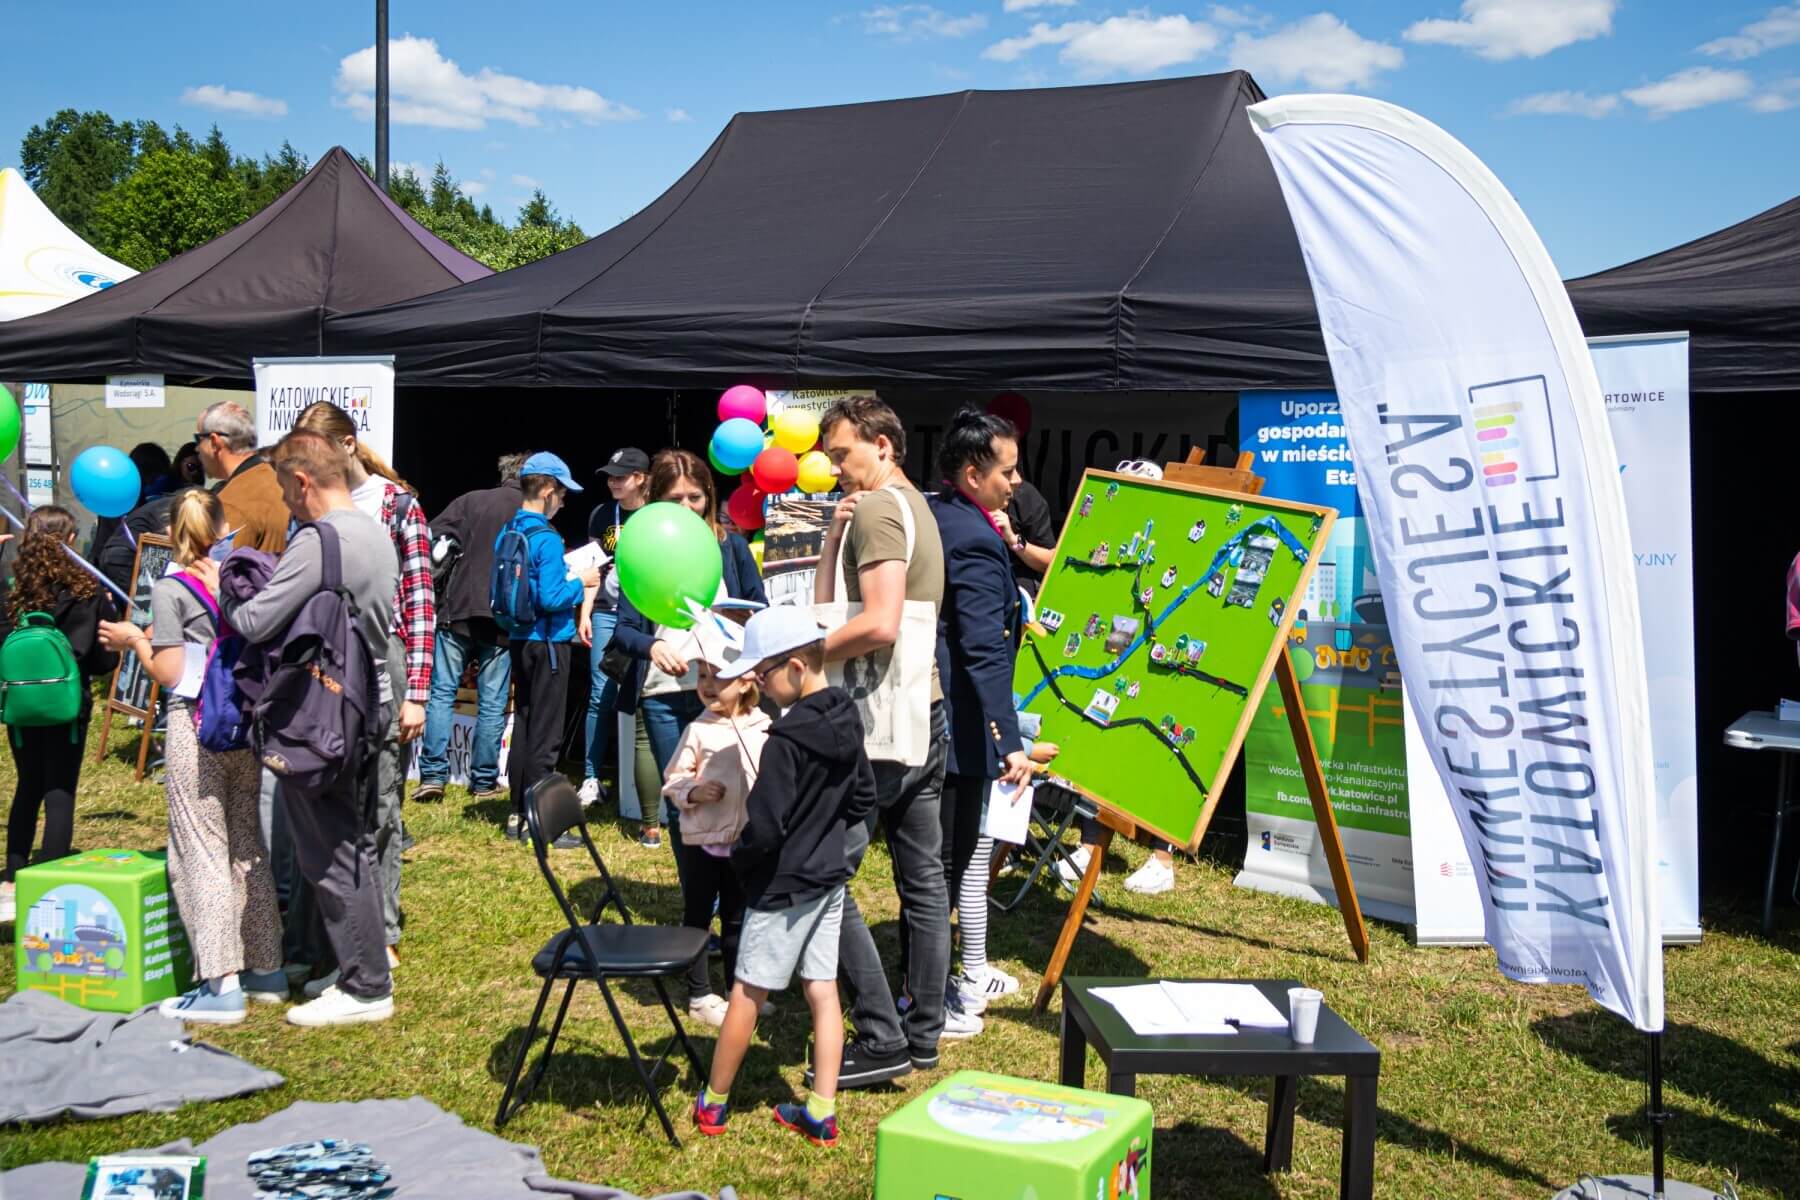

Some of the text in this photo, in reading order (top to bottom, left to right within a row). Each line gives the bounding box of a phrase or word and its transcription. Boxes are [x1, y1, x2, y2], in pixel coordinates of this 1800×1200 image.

[270, 386, 350, 409] KATOWICKIE
[1604, 391, 1665, 404] ATOWICE
[1261, 450, 1279, 463] w
[1326, 468, 1358, 486] Eta
[1346, 762, 1408, 777] Infrastruktu
